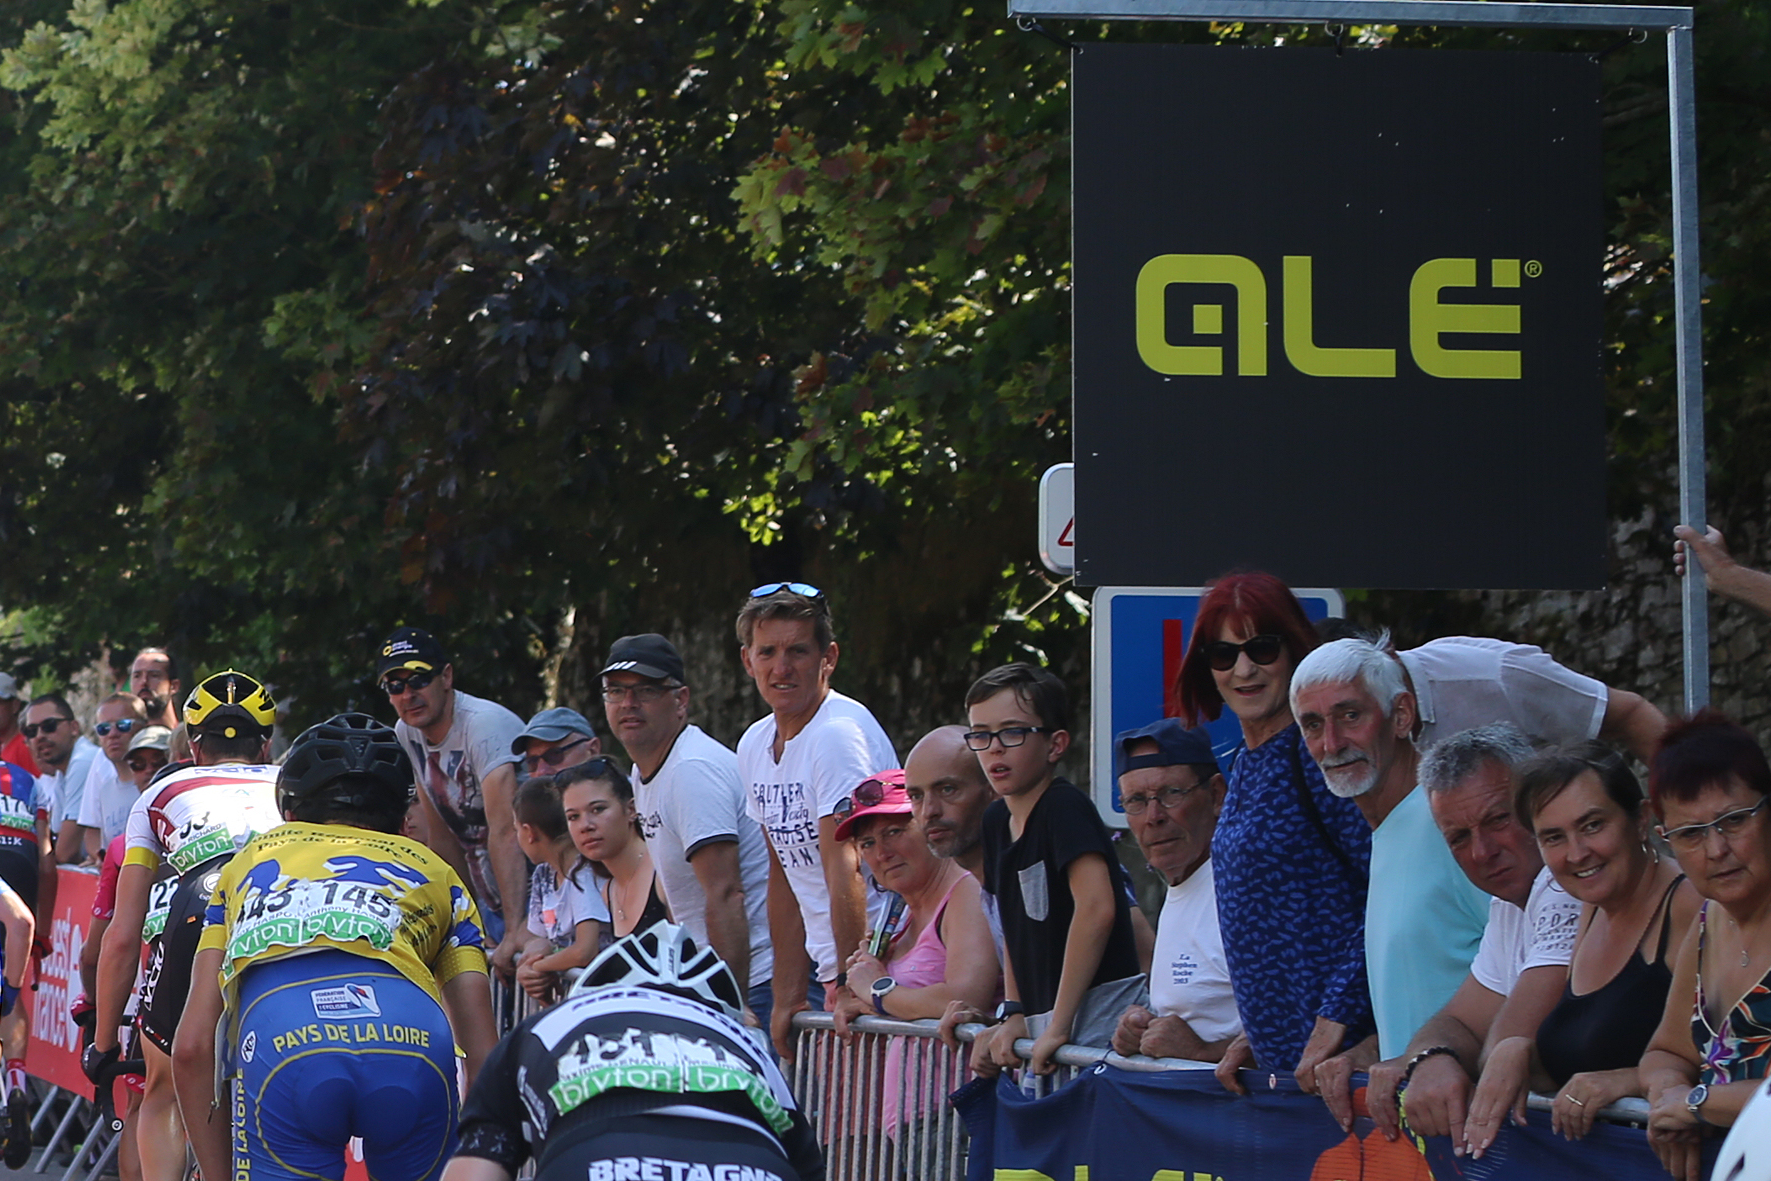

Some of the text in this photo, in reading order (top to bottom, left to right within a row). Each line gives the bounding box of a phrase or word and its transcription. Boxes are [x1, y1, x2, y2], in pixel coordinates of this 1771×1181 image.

[173, 832, 228, 866] bryton
[273, 1024, 321, 1052] PAYS
[325, 1023, 351, 1043] DE
[355, 1022, 383, 1043] LA
[384, 1024, 430, 1048] LOIRE
[560, 1068, 672, 1107] bryton
